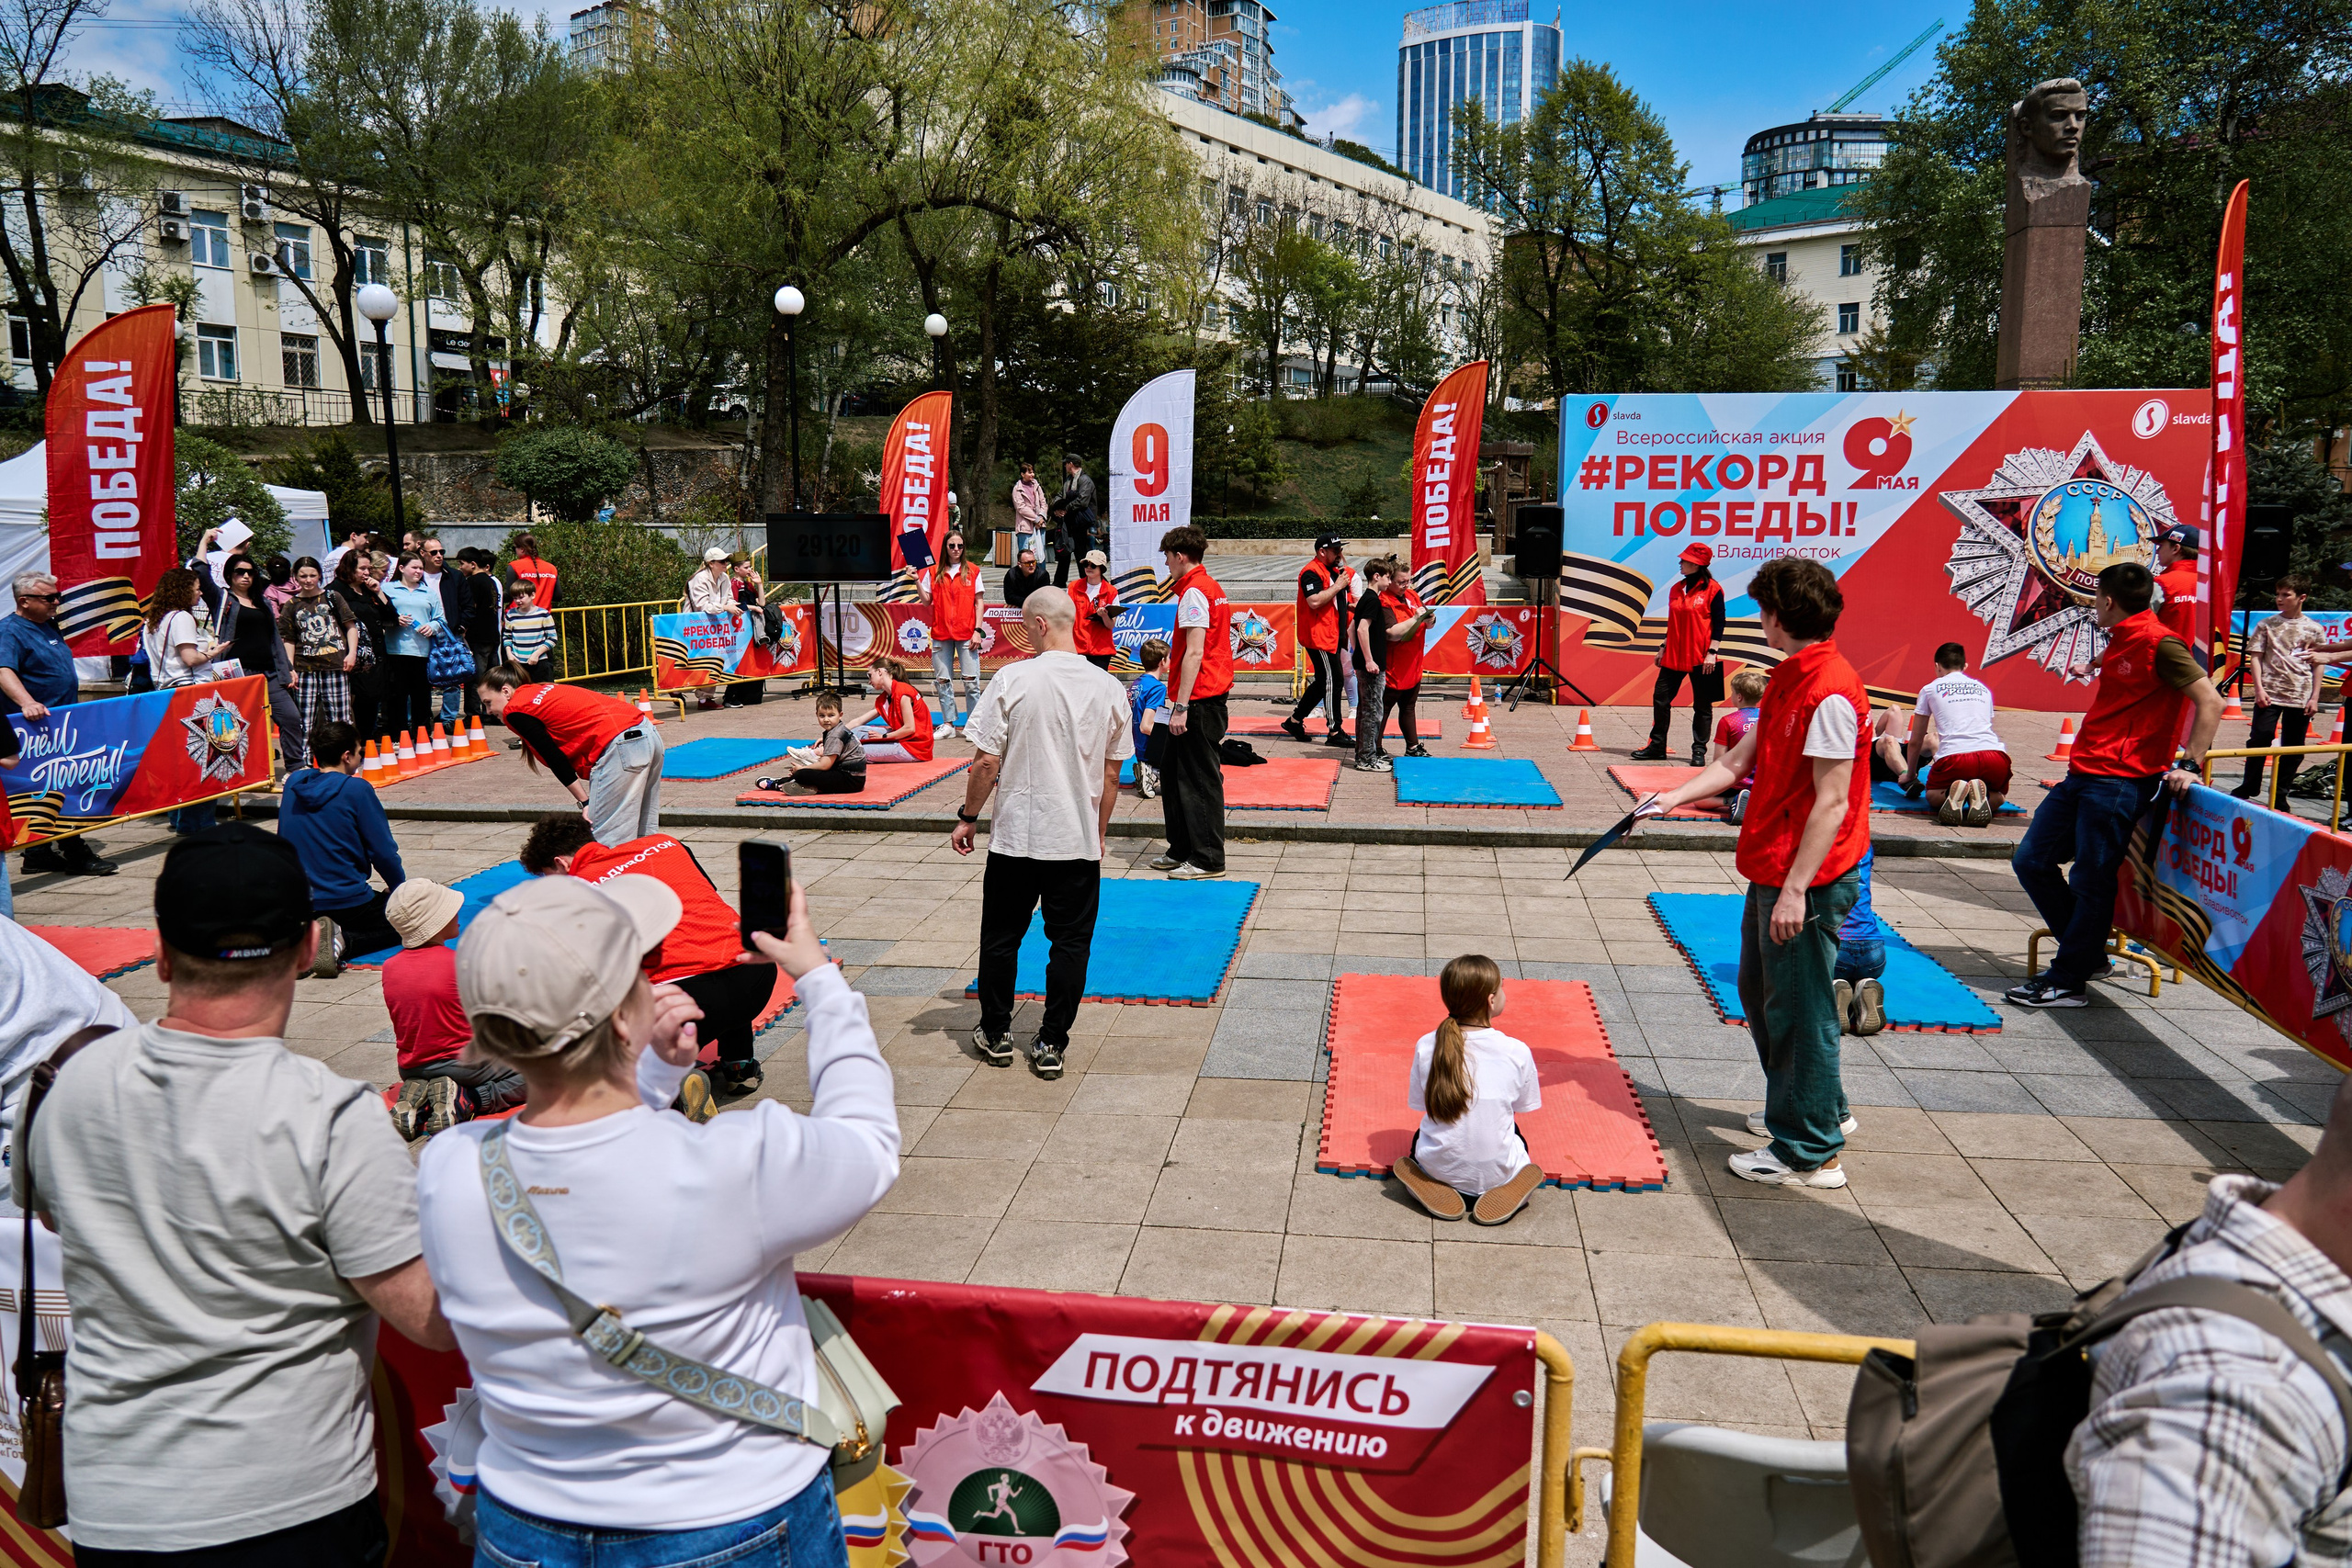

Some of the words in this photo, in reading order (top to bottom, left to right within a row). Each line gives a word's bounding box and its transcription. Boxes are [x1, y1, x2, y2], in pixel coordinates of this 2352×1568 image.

[1612, 411, 1642, 421] slavda
[1616, 429, 1763, 446] Всероссийская
[1770, 431, 1826, 446] акция
[84, 360, 143, 559] ПОБЕДА!
[1132, 423, 1170, 497] 9
[1579, 453, 1827, 496] #РЕКОРД
[1843, 416, 1913, 490] 9
[902, 421, 935, 553] ОБЕДА!
[1425, 402, 1457, 549] ПОБЕДА!
[1877, 476, 1919, 490] МАЯ
[2066, 481, 2124, 501] СССР
[1132, 503, 1170, 523] МАЯ
[1613, 501, 1859, 544] ПОБЕДЫ!
[797, 534, 861, 558] 29120
[1711, 544, 1840, 560] .Владивосток
[683, 623, 729, 637] #РЕКОРД
[690, 636, 737, 649] ПОБЕДЫ!
[30, 740, 129, 812] Победы!
[2232, 817, 2253, 866] 9
[2159, 837, 2238, 900] ПОБЕДЫ!
[1083, 1349, 1411, 1416] ПОДТЯНИСЬ
[1173, 1411, 1196, 1436] к
[1201, 1406, 1388, 1459] движению
[978, 1540, 1033, 1565] ГТО
